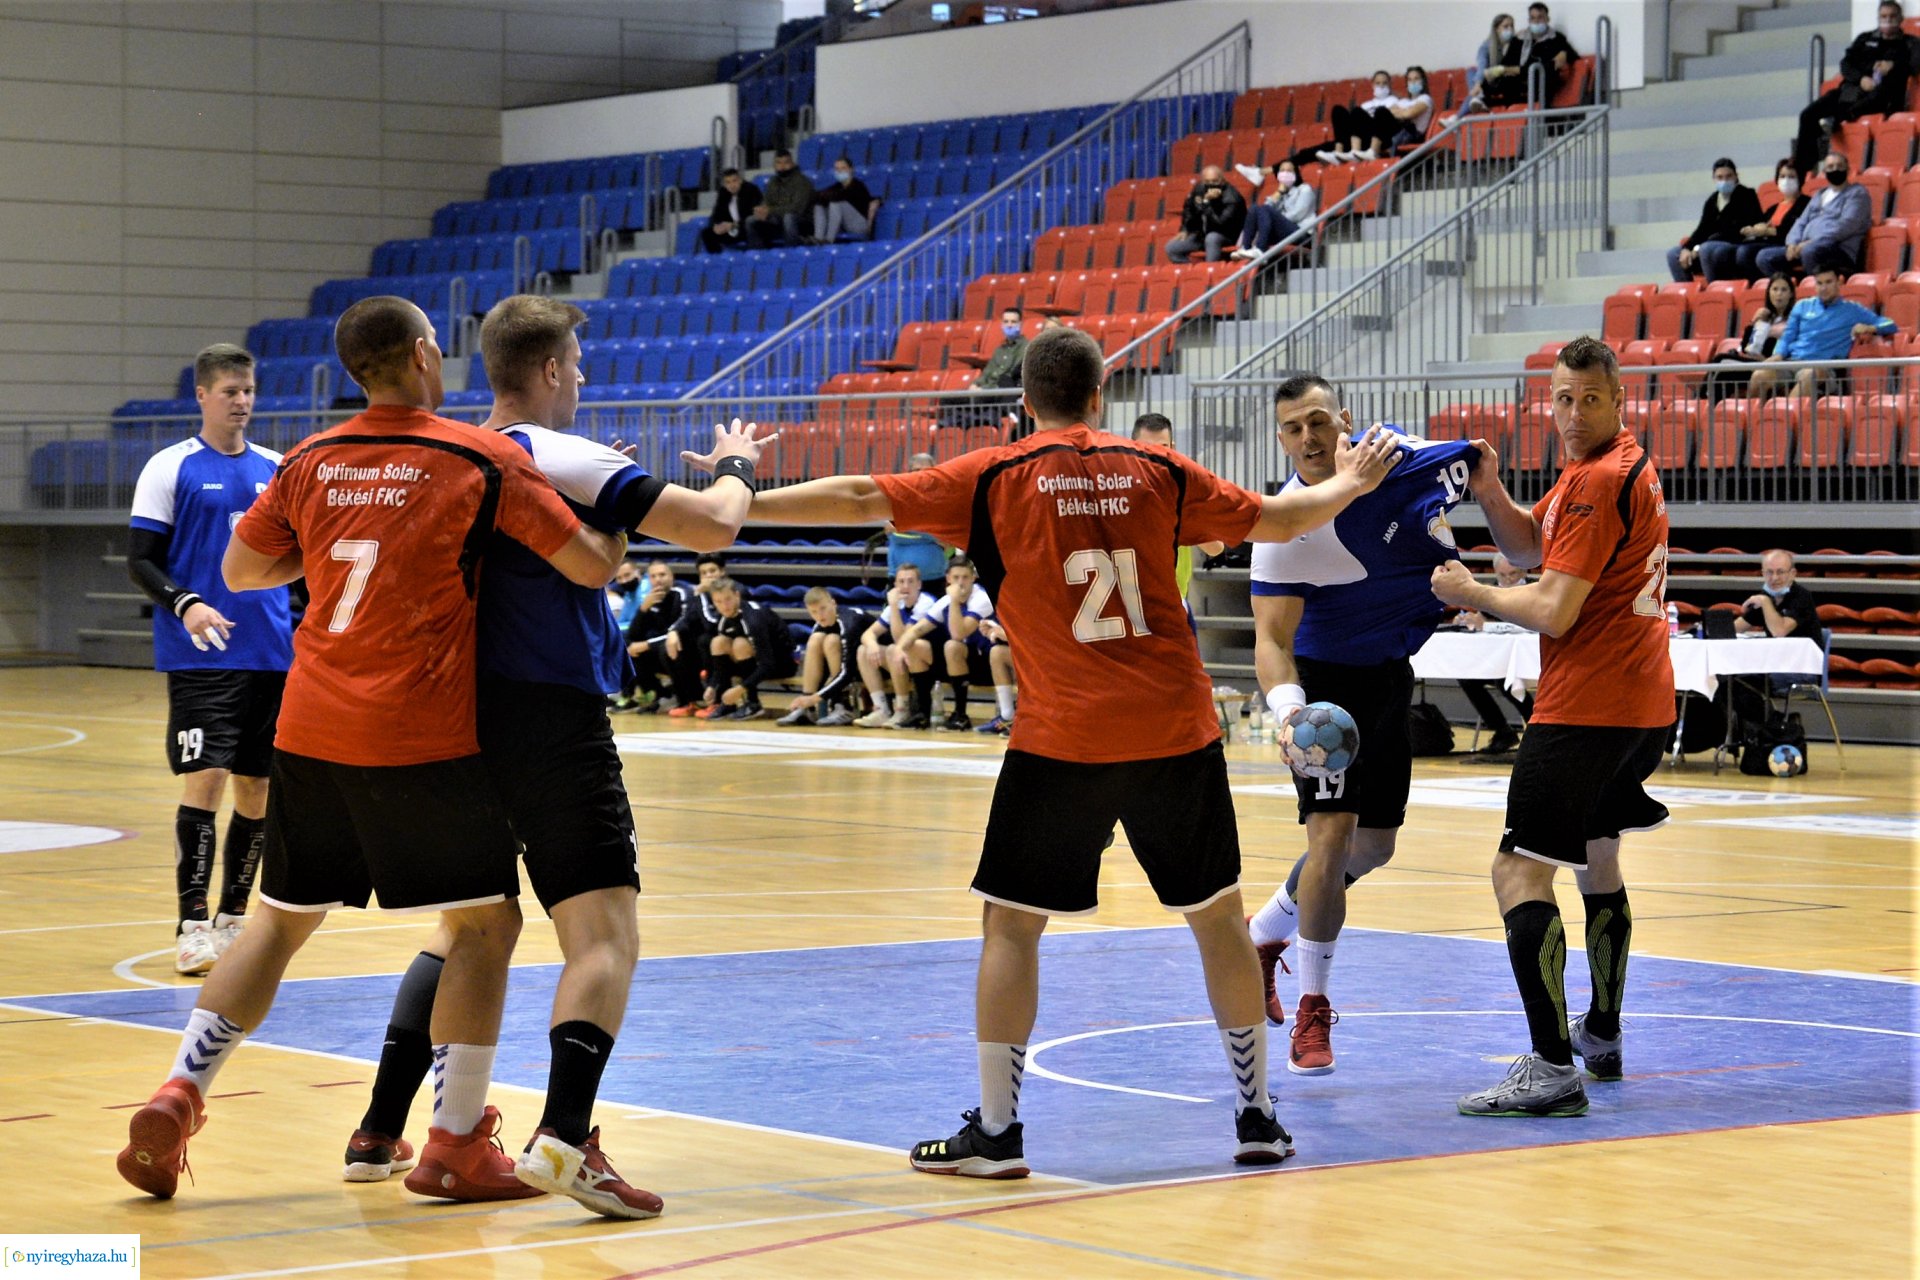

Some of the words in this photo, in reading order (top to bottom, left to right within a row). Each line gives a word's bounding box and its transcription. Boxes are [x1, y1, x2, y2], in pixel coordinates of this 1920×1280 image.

[317, 462, 380, 485] Optimum
[382, 463, 422, 482] Solar
[1096, 473, 1133, 491] Solar
[1436, 460, 1470, 504] 19
[327, 487, 375, 507] Békési
[375, 487, 407, 507] FKC
[1100, 497, 1130, 516] FKC
[1382, 521, 1399, 544] JAKO
[328, 539, 380, 633] 7
[1063, 548, 1152, 643] 21
[177, 727, 204, 763] 29
